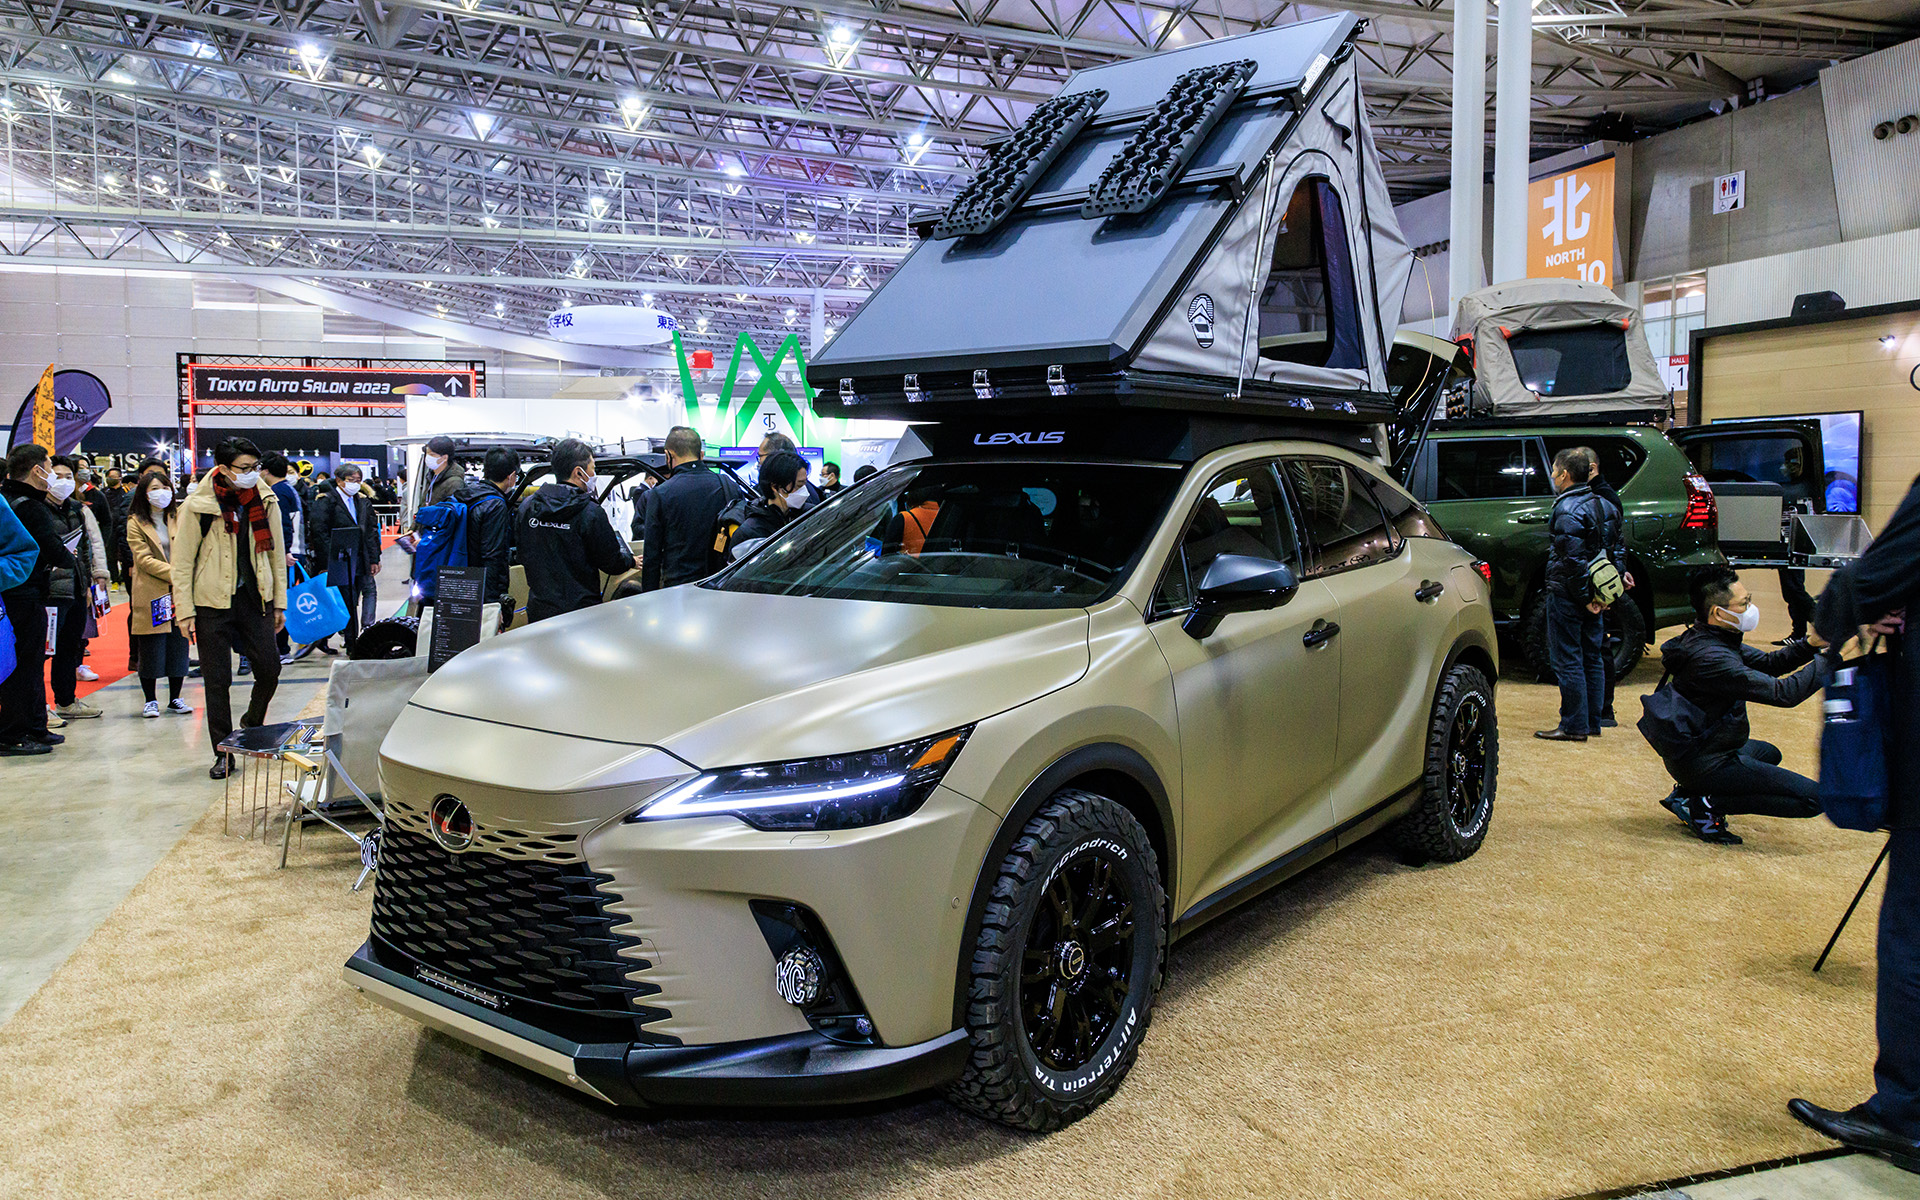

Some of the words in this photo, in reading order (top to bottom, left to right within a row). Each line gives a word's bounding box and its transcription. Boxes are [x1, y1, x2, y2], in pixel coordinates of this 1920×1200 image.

[1542, 174, 1591, 246] 北
[1545, 247, 1585, 268] NORTH
[1577, 260, 1606, 285] 10
[656, 314, 678, 331] 東京
[207, 377, 256, 392] TOKYO
[260, 378, 300, 393] AUTO
[302, 379, 350, 394] SALON
[352, 381, 391, 395] 2023
[973, 431, 1065, 446] LEXUS
[540, 520, 570, 530] LEXUS
[361, 836, 378, 869] KC
[1041, 838, 1128, 896] BFGoodrich
[776, 959, 806, 1004] KC
[1063, 1007, 1136, 1092] All-Terrain
